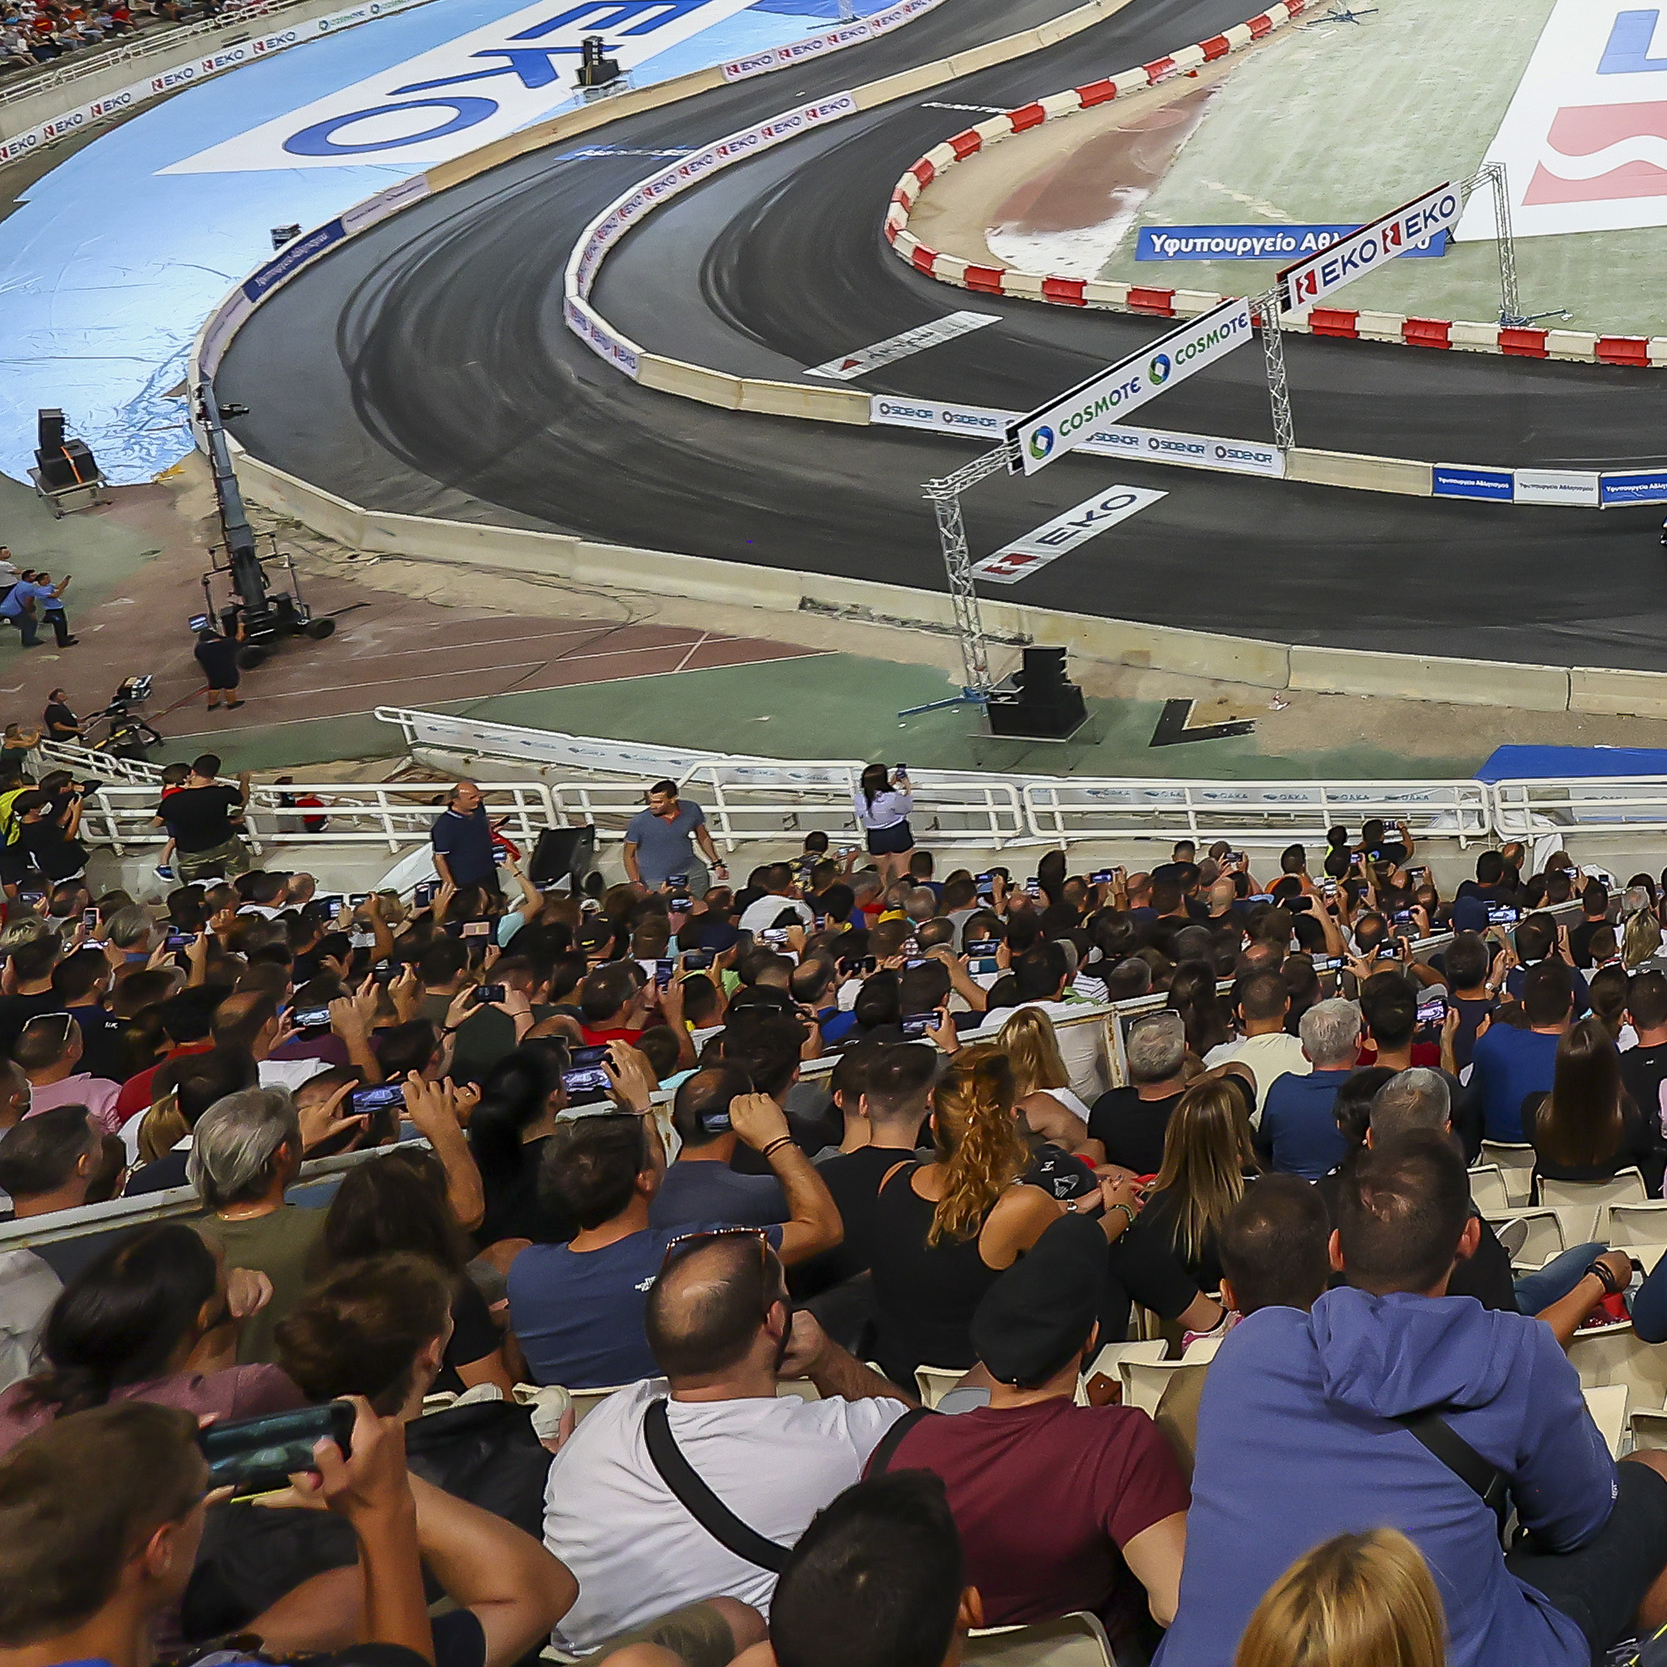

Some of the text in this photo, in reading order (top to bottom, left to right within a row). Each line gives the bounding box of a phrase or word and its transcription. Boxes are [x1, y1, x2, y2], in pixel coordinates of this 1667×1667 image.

[9, 31, 296, 155] EKO EKO EKO EKO EKO EKO
[729, 134, 758, 152] EKO
[774, 116, 801, 133] EKO
[819, 98, 850, 116] EKO
[1151, 234, 1296, 254] Υφυπουργείο
[1321, 239, 1377, 287] EKO
[1404, 195, 1456, 238] EKO
[1059, 312, 1249, 436] COSMOTE COSMOTE
[1161, 441, 1205, 454] SIDENOR
[1228, 449, 1272, 463] SIDENOR
[1438, 477, 1509, 488] Υφυπουργείο Αθλητισμού
[1559, 484, 1593, 492] Αθλητισμού
[1606, 485, 1648, 493] Υφυπουργείο
[1035, 494, 1137, 545] EKO
